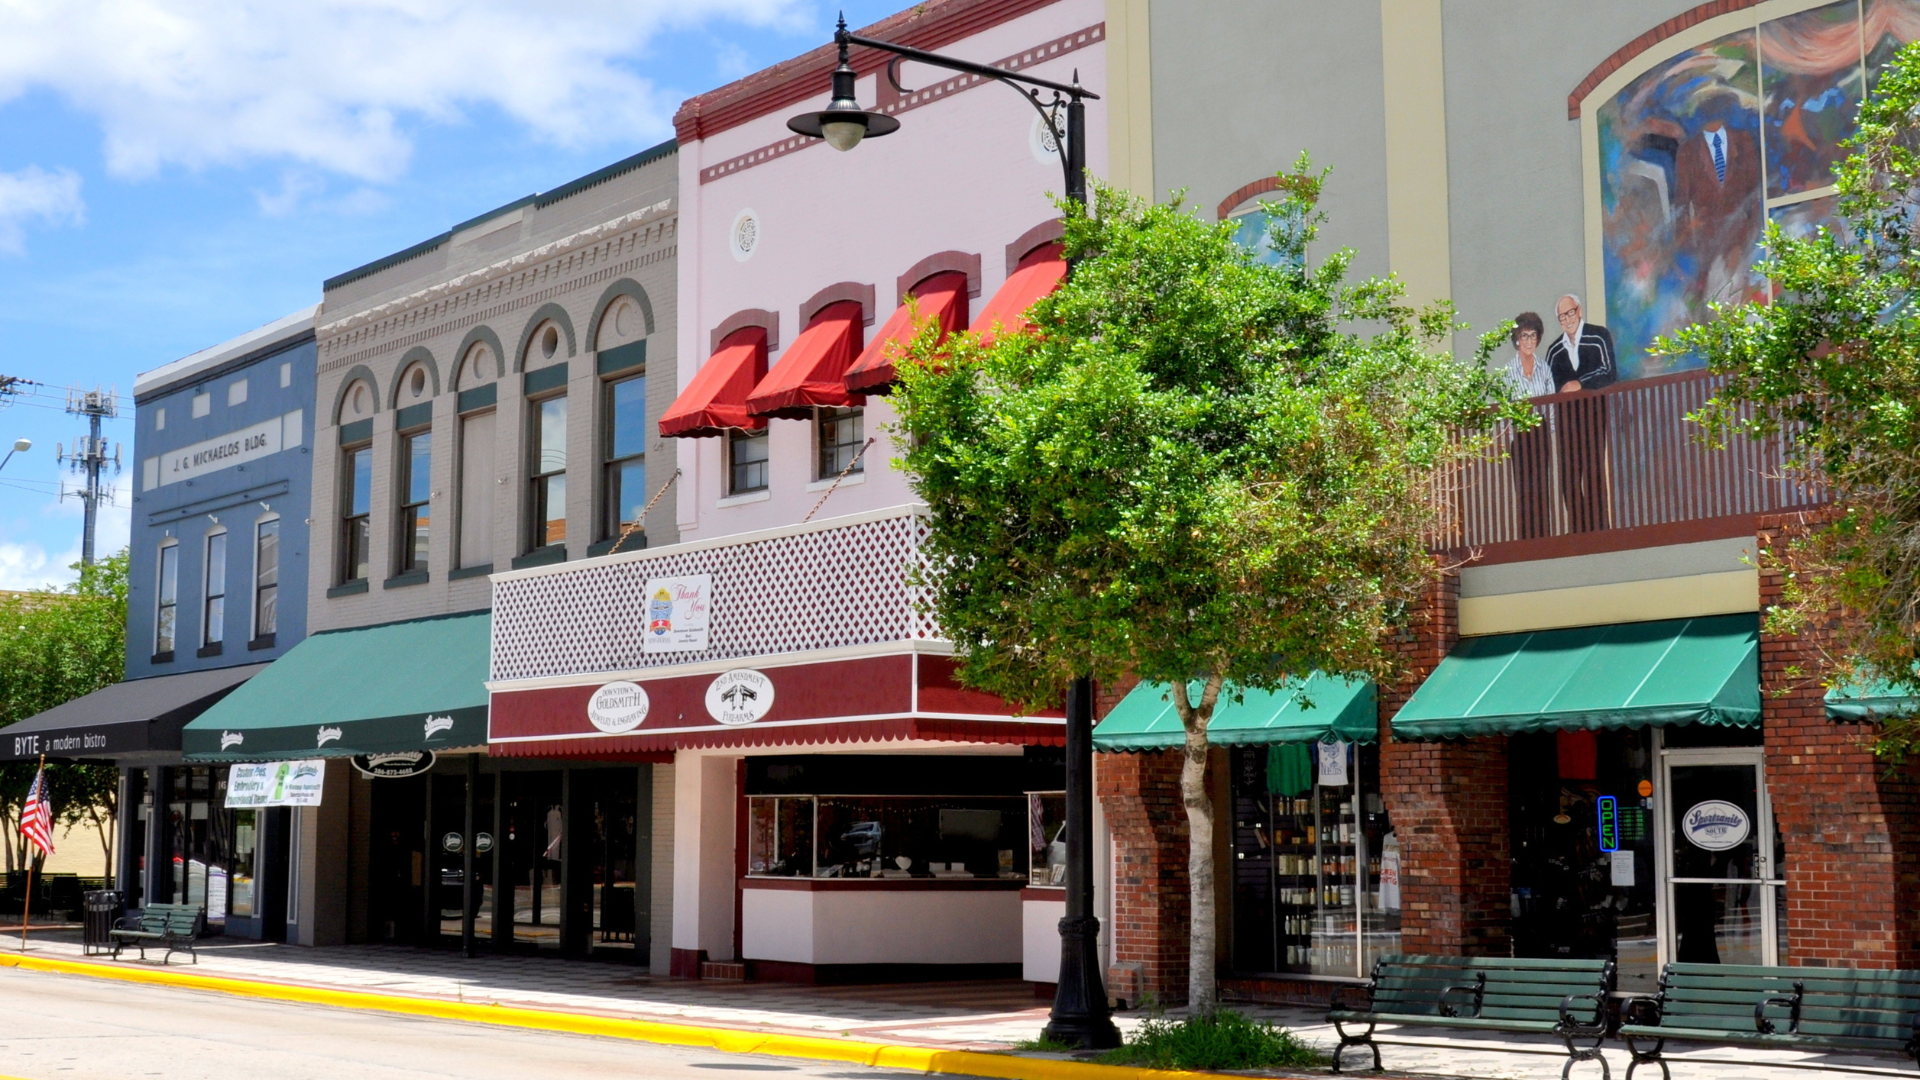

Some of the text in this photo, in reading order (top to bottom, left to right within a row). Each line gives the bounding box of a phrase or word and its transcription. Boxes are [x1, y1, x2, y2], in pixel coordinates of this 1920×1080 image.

[174, 459, 180, 472] J.
[193, 441, 239, 467] MICHAELOS
[244, 433, 268, 451] BLDG.
[671, 583, 701, 601] Thank
[602, 686, 634, 697] DOWNTOWN
[596, 692, 641, 710] GOLDSMITH
[722, 710, 755, 722] FIREARMS
[15, 733, 106, 756] BYTE a modern bistro
[1601, 799, 1615, 849] OPEN
